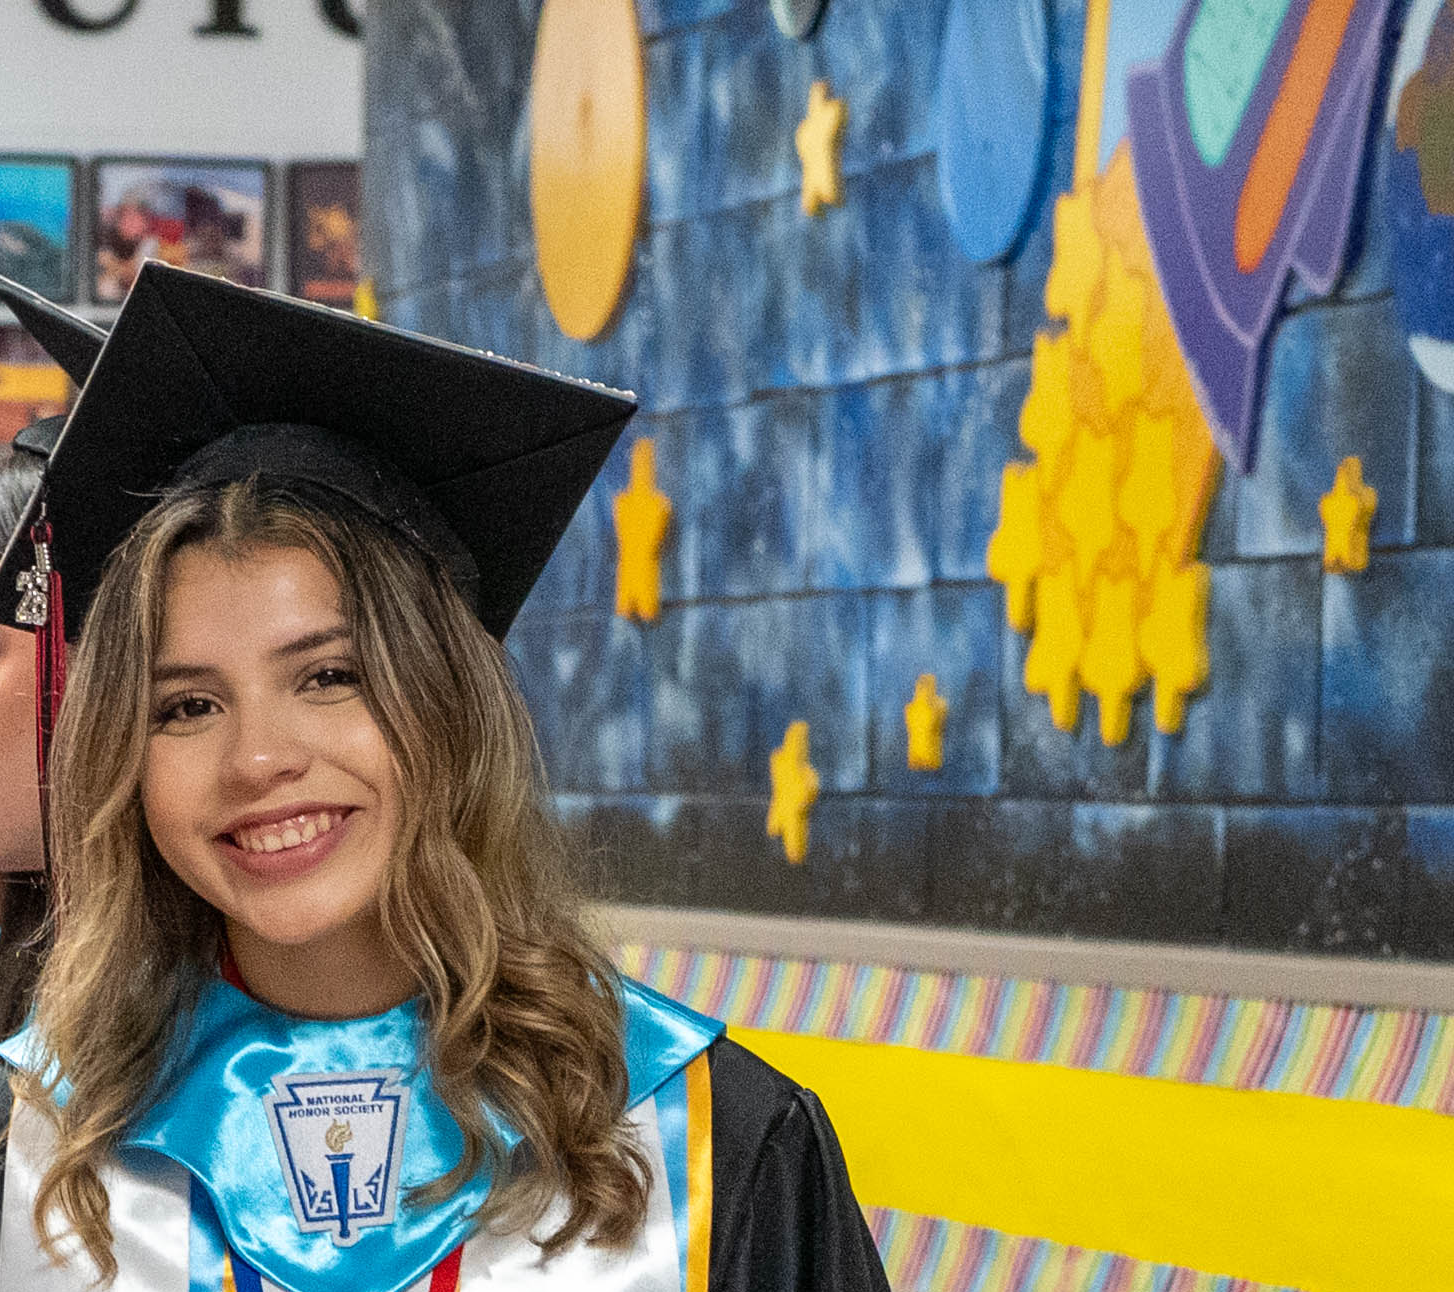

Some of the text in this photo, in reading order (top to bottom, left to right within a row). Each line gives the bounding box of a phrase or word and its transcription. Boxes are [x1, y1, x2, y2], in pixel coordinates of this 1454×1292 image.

[307, 1093, 365, 1106] NATIONAL
[289, 1103, 384, 1119] HONOR SOCIETY
